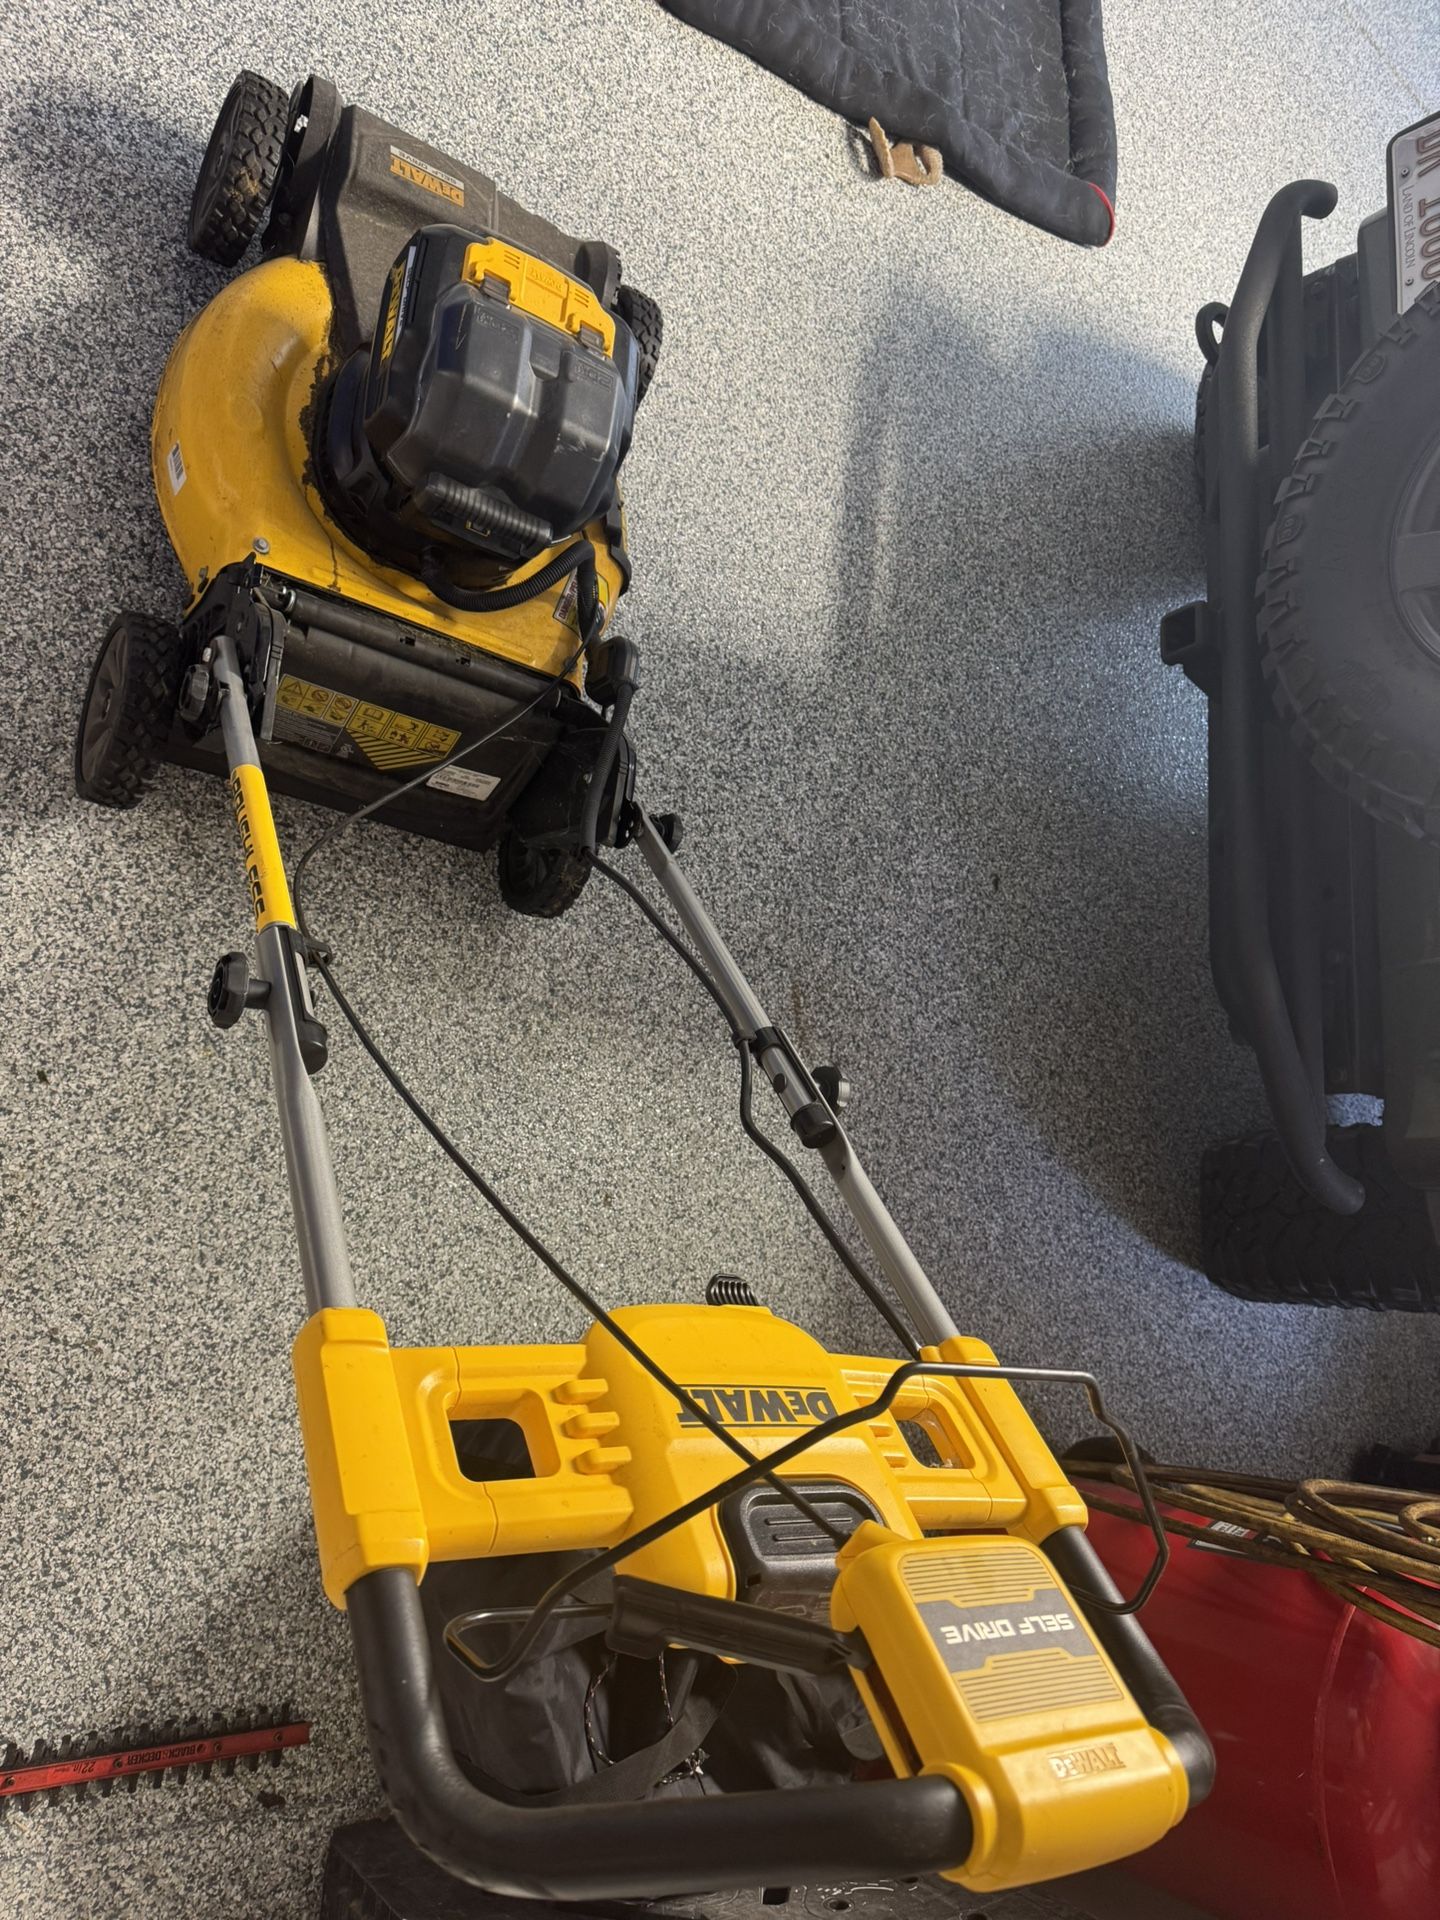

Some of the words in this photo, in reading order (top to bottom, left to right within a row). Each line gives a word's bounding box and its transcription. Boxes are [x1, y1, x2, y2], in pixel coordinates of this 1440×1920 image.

[1402, 185, 1416, 215] LAND
[1403, 215, 1415, 228] OF
[1405, 227, 1417, 269] LINCOLN
[940, 1618, 1016, 1645] DRIVE
[1019, 1612, 1076, 1636] SELF
